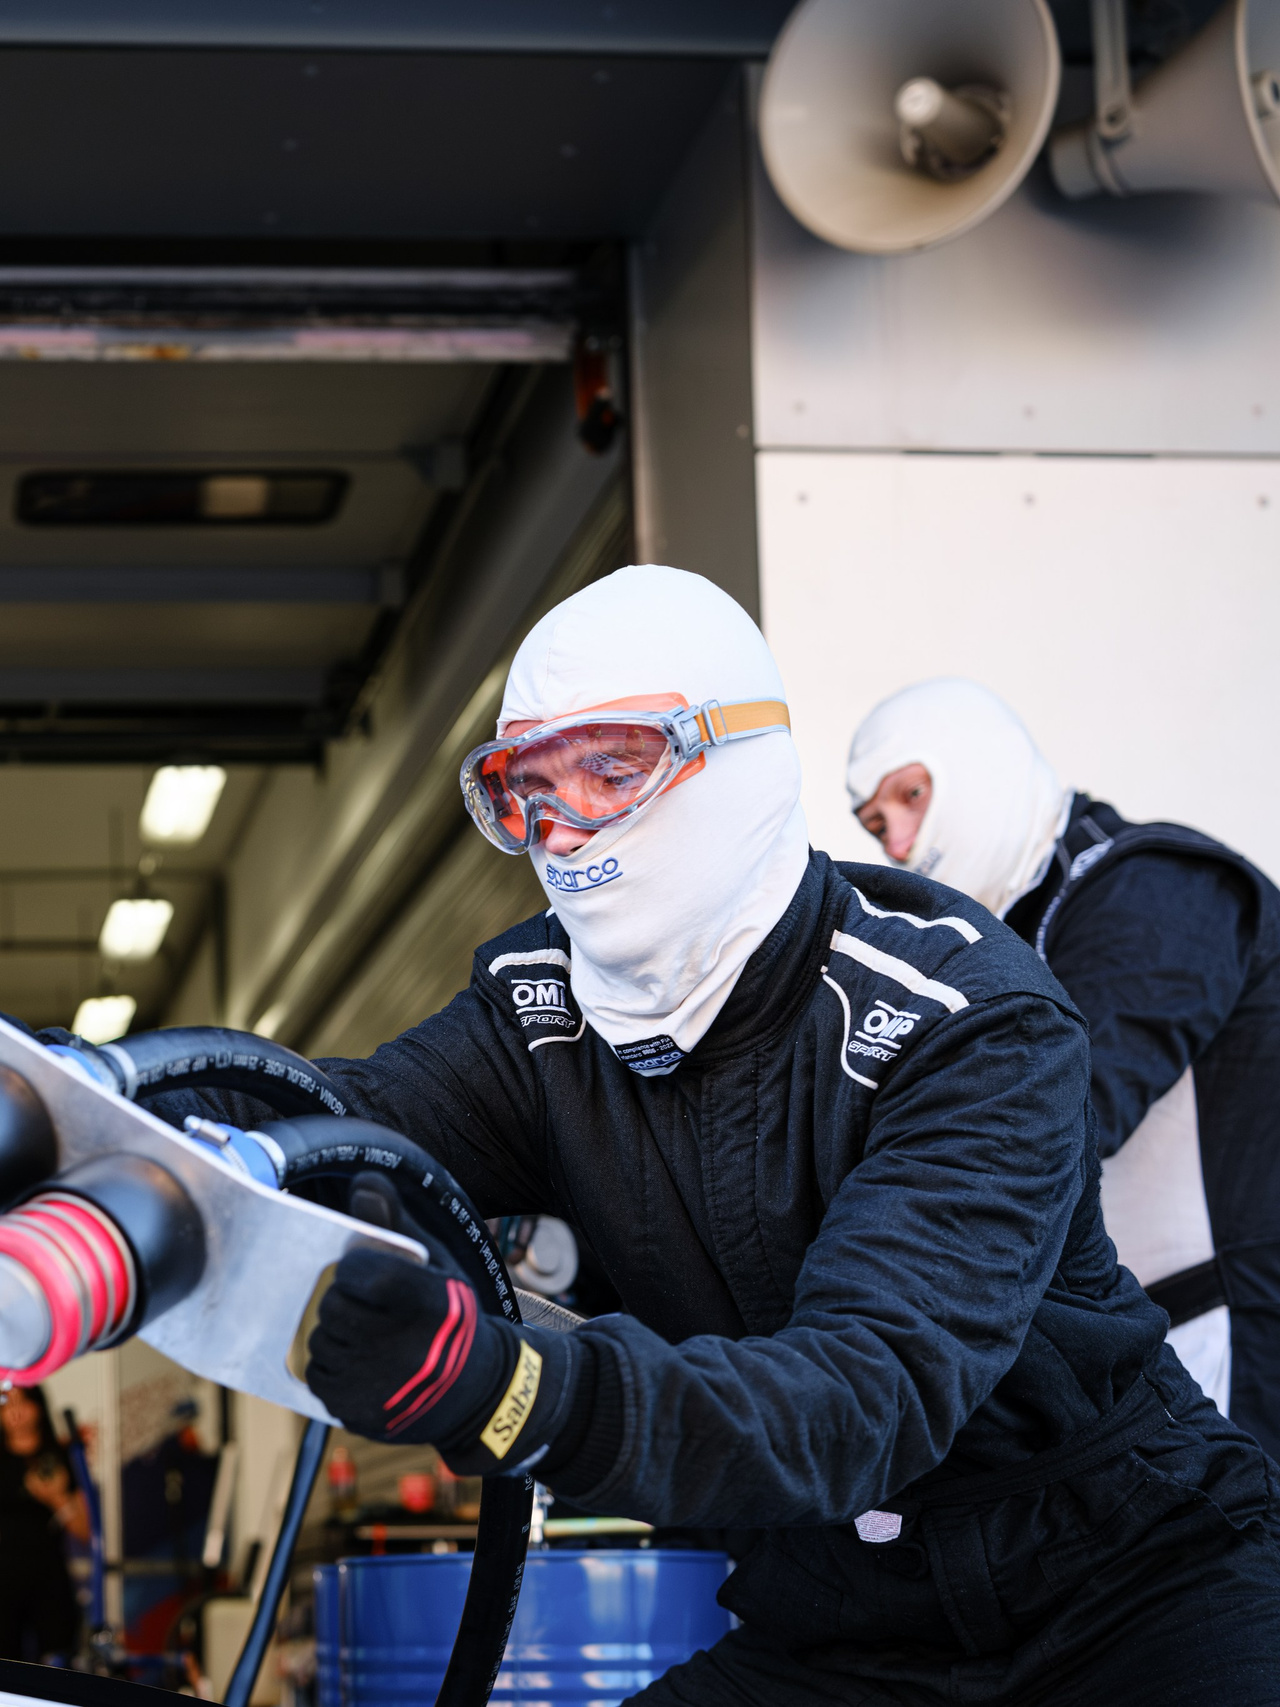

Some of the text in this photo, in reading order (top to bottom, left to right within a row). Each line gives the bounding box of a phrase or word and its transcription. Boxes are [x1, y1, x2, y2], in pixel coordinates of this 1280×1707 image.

[545, 856, 619, 890] sparco
[628, 1051, 683, 1070] sparco
[465, 1220, 481, 1243] SAE
